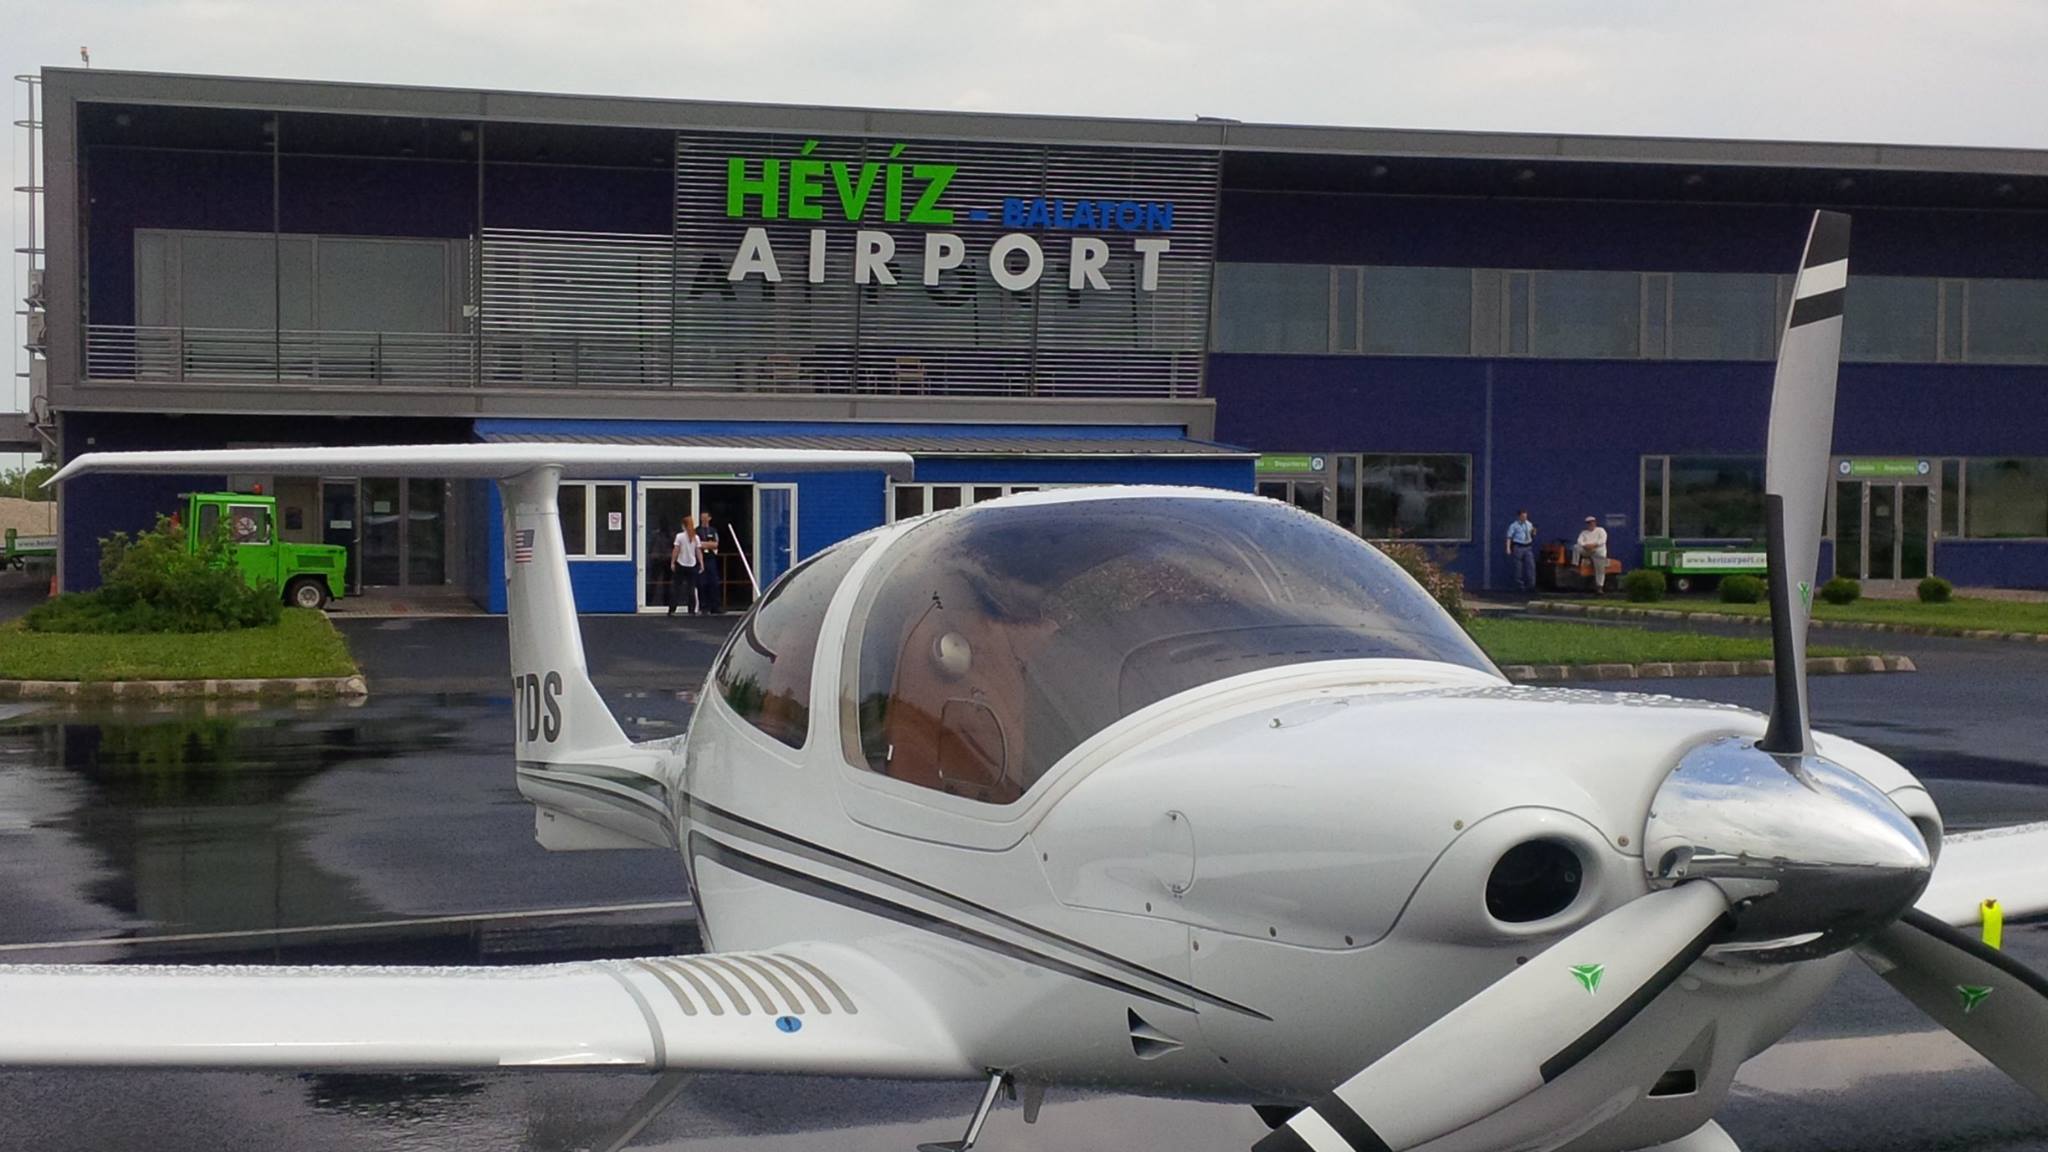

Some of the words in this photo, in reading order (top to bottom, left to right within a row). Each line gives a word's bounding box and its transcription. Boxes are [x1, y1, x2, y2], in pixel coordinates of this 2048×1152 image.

[727, 139, 958, 224] HÉVÍZ
[1002, 198, 1174, 231] BALATON
[727, 227, 1170, 291] AIRPORT
[513, 670, 562, 743] 7DS
